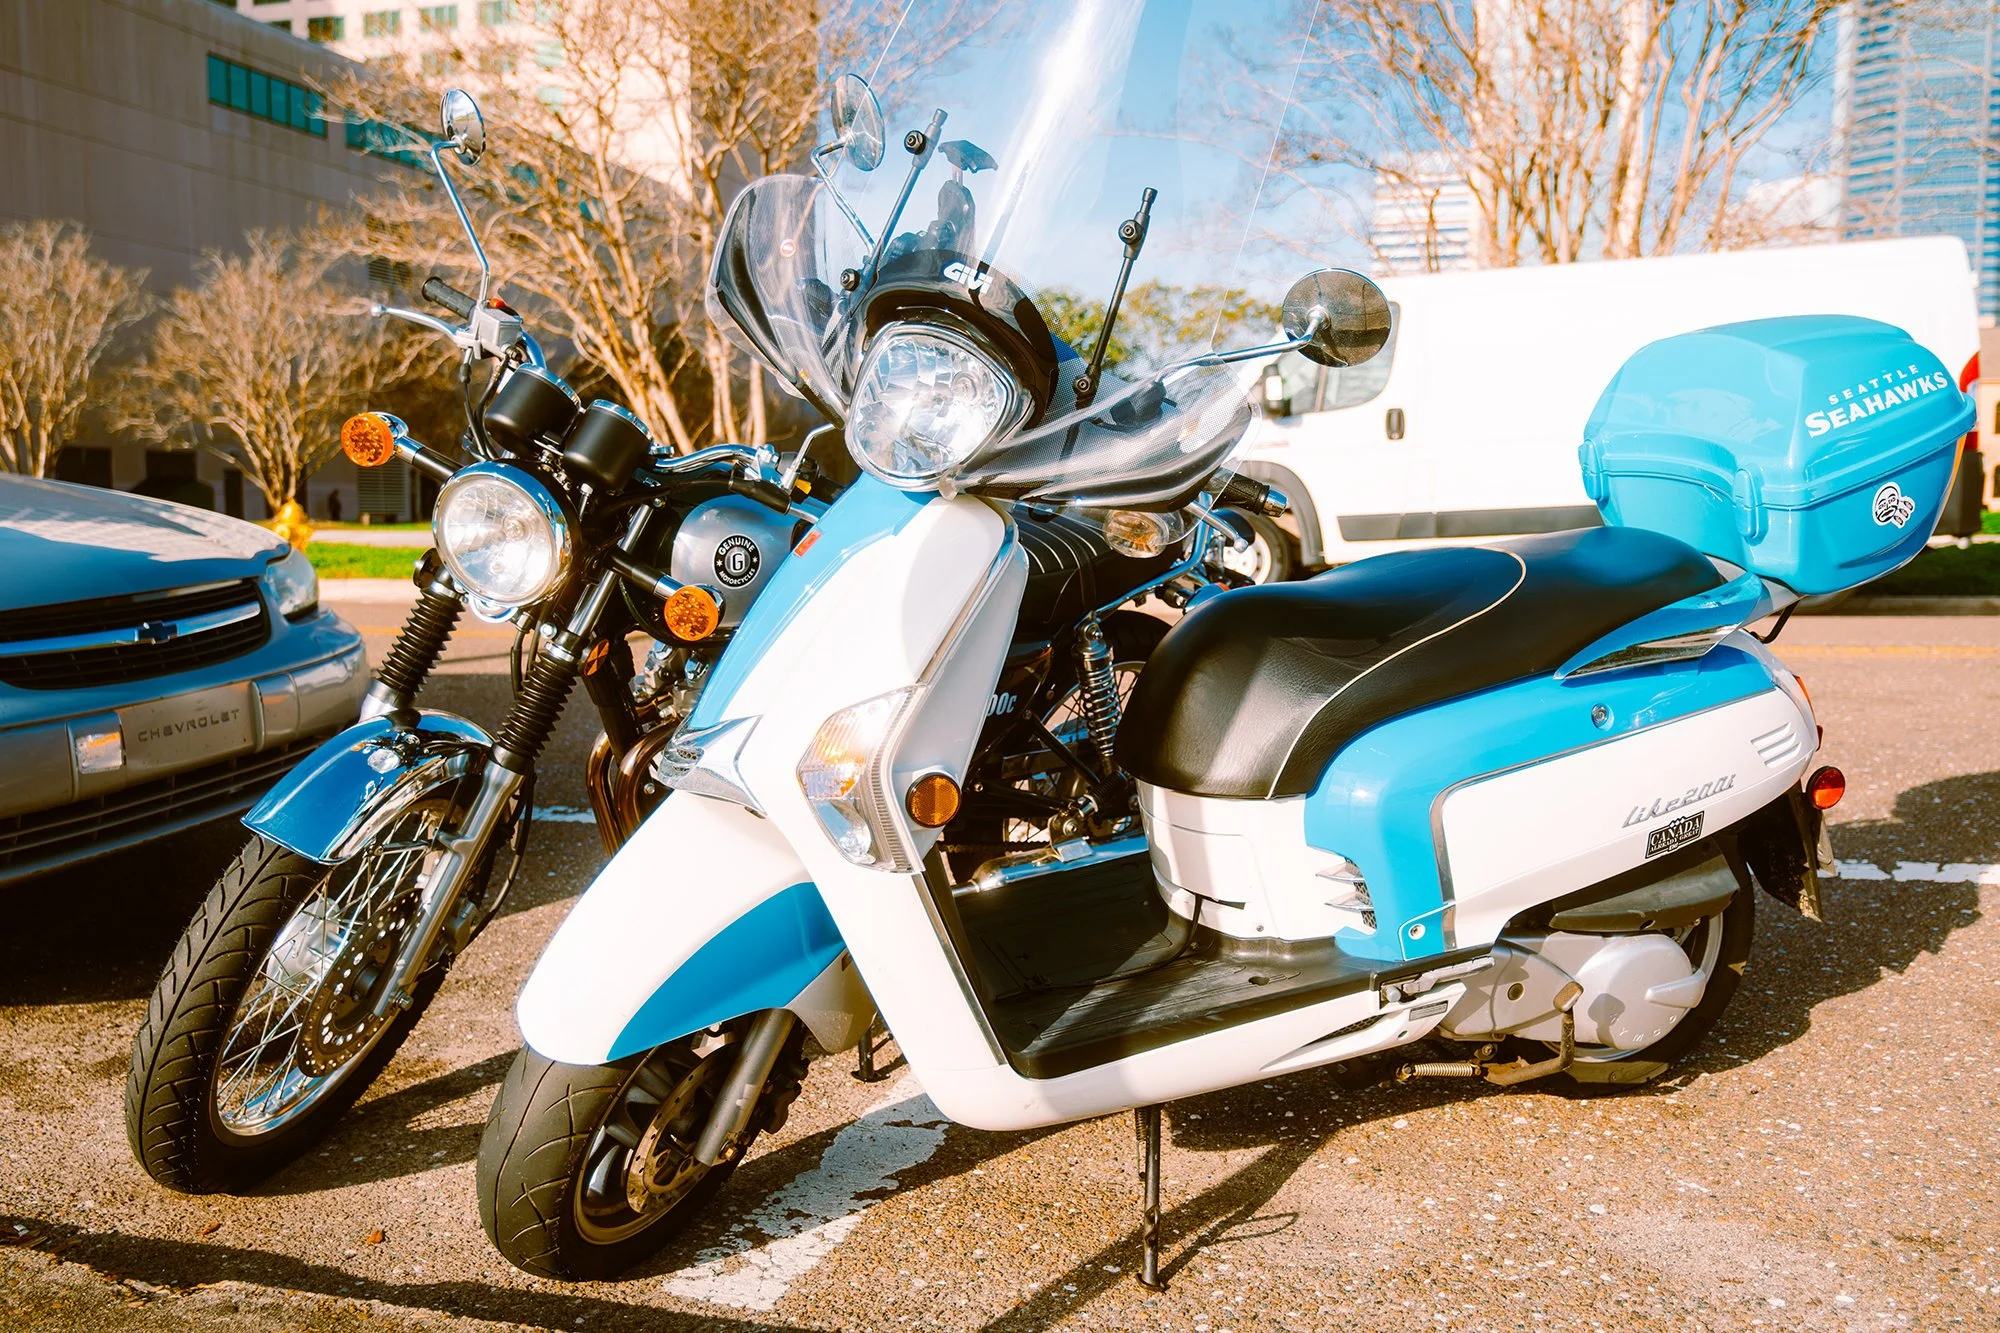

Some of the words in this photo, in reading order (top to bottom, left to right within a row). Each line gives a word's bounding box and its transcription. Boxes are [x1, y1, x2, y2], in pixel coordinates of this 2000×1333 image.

[943, 262, 993, 295] GIVI
[1828, 364, 1919, 405] SEATTLE
[1805, 371, 1948, 438] SEAHAWKS
[718, 537, 755, 555] GENUINE
[719, 568, 755, 584] MOTORCYCLES
[730, 551, 746, 573] G
[137, 708, 240, 742] CHEVROLET
[1649, 836, 1679, 853] ALREADY
[1679, 828, 1699, 841] GREAT
[1650, 817, 1701, 847] CANADA
